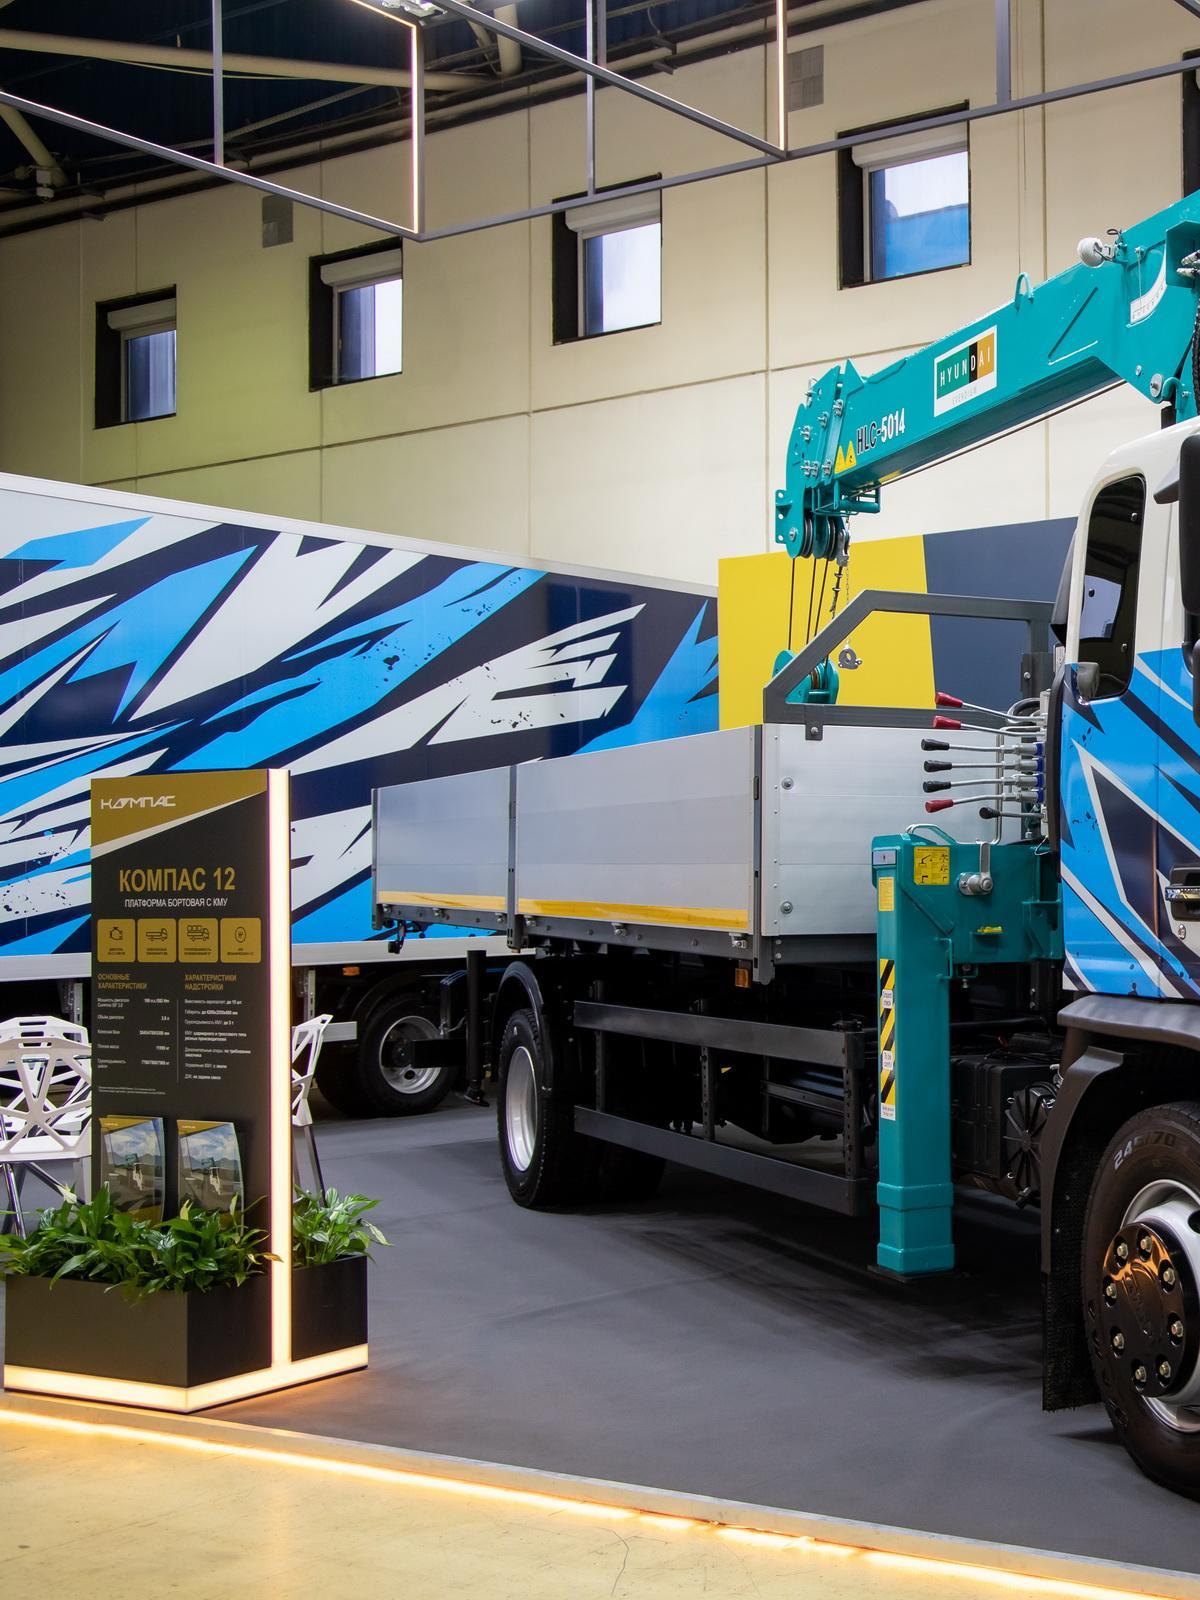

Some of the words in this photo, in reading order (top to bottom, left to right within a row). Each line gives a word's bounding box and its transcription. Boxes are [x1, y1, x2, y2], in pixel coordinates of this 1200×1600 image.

[940, 346, 991, 387] HYUNDAI
[856, 408, 906, 455] HLC-5014
[119, 867, 206, 893] КОМПАС
[213, 866, 236, 891] 12
[124, 899, 167, 908] ПЛАТФОРМА
[168, 898, 205, 907] БОРТОВАЯ
[213, 898, 228, 907] КМУ
